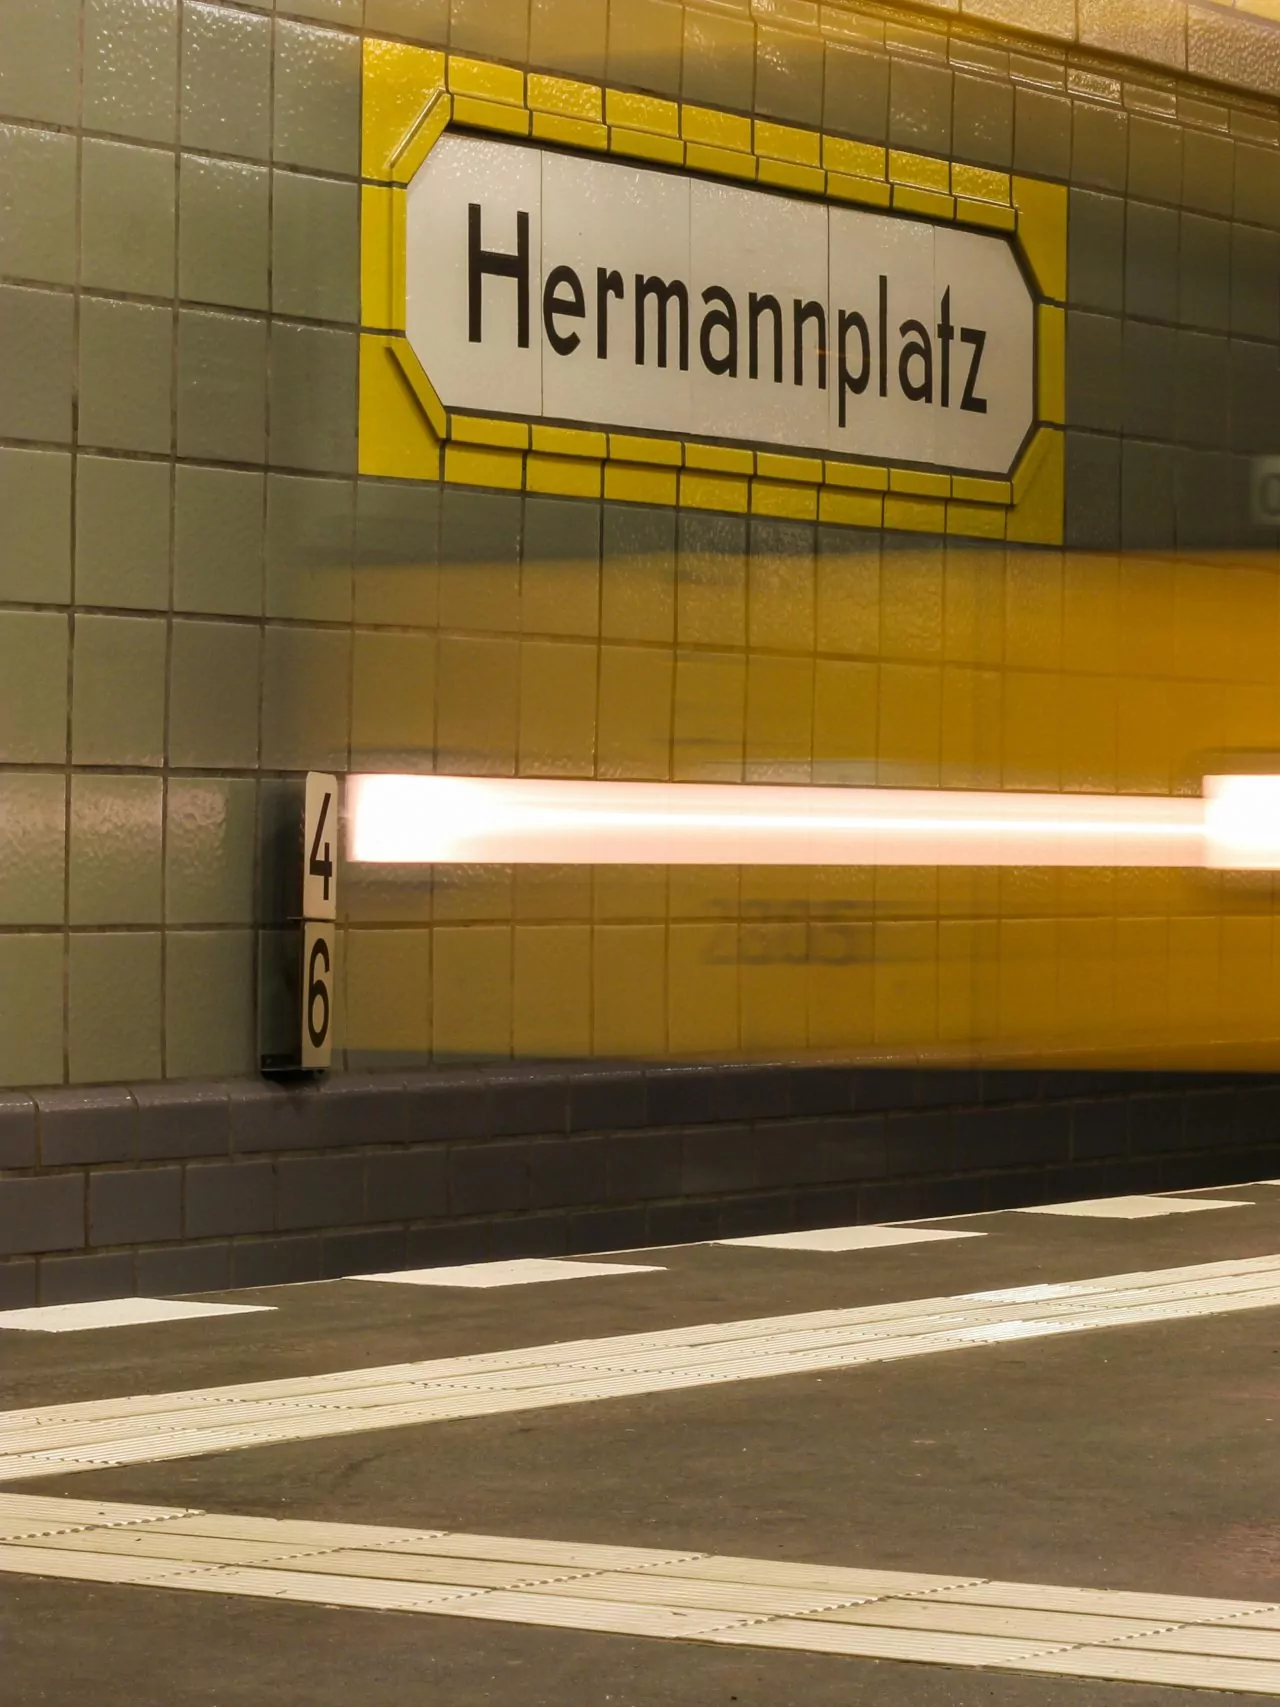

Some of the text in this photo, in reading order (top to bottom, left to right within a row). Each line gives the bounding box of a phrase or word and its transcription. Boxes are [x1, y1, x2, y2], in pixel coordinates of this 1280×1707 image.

[467, 202, 988, 428] Hermannplatz
[308, 792, 333, 901] 4
[307, 937, 331, 1049] 6
